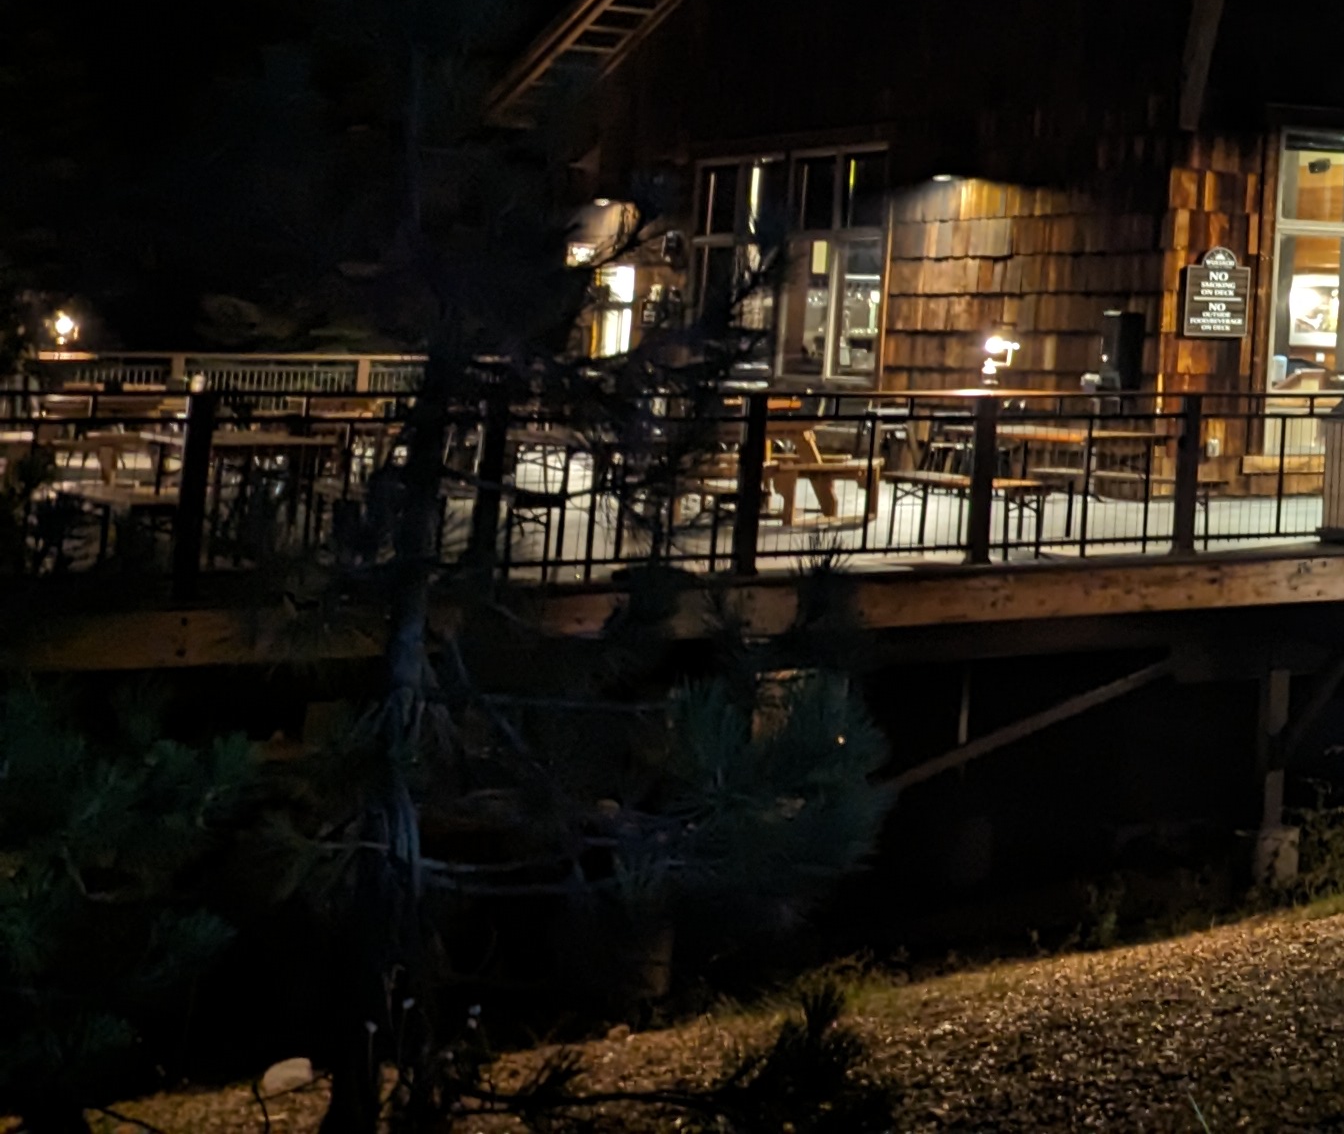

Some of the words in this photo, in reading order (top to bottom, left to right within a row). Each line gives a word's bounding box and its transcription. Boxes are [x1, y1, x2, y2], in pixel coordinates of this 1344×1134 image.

[1209, 271, 1229, 281] NO
[1201, 281, 1236, 289] SMOKING
[1214, 289, 1235, 297] DECK
[1208, 302, 1226, 311] NO
